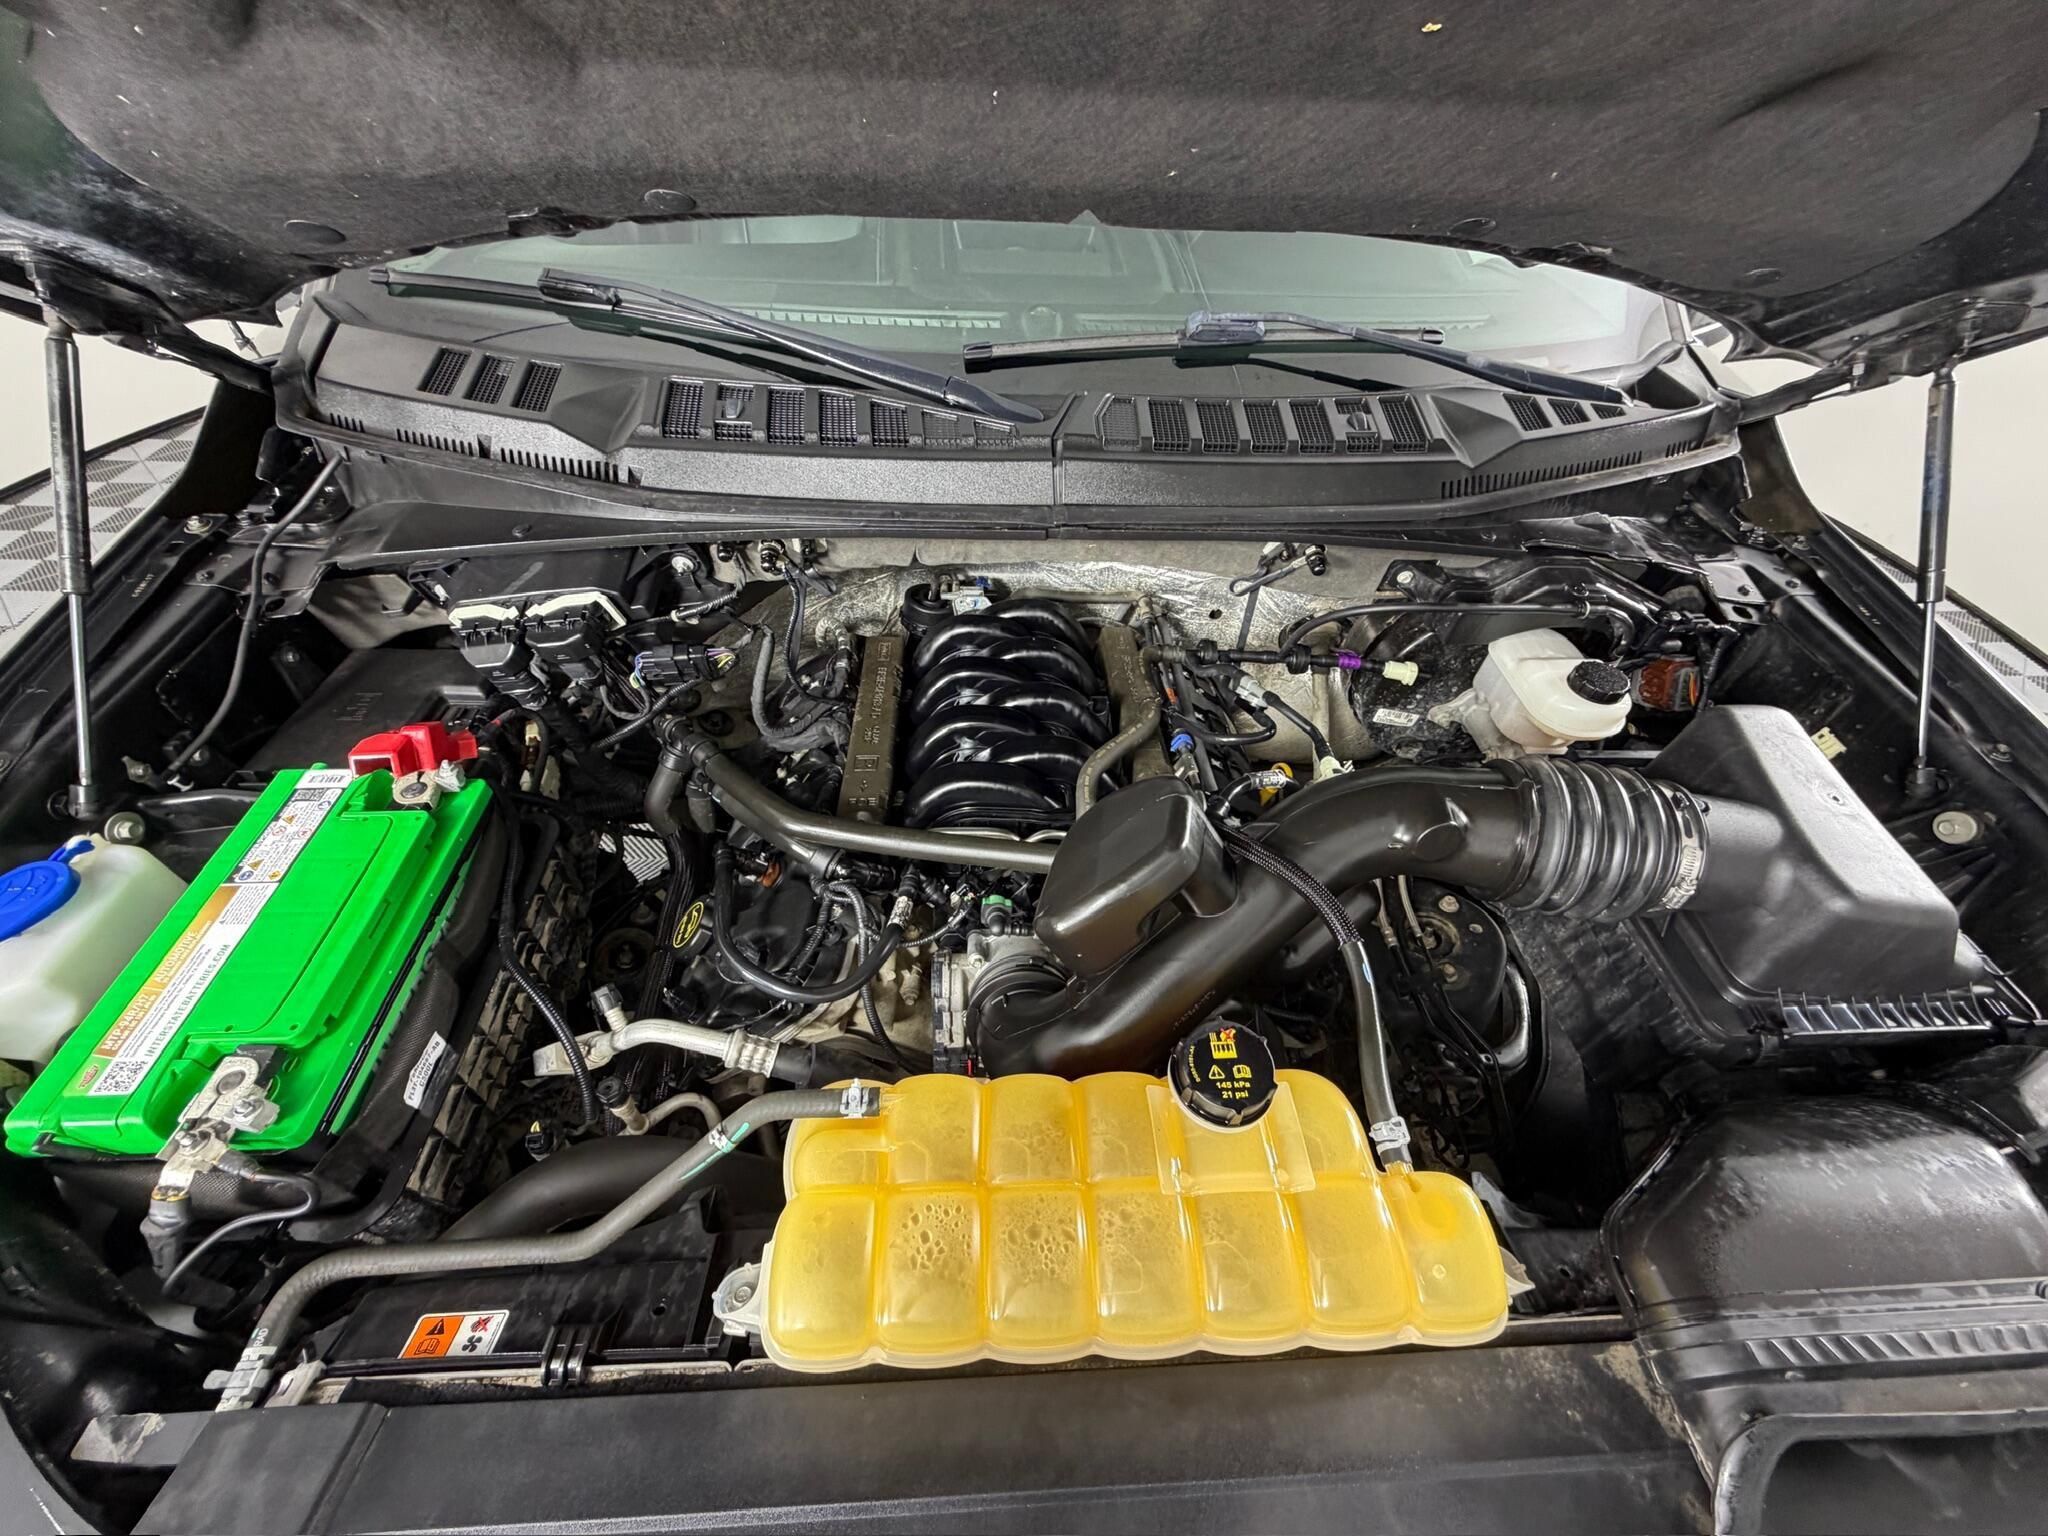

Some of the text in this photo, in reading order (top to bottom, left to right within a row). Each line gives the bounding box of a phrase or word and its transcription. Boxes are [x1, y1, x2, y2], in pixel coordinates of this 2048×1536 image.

[154, 931, 199, 983] AUTOMOTIVE
[144, 944, 231, 1057] INTERSTATEBATTERIES.COM
[1216, 1080, 1251, 1089] 145 kPa
[1222, 1090, 1249, 1100] 21 psi
[253, 1328, 269, 1346] RAD
